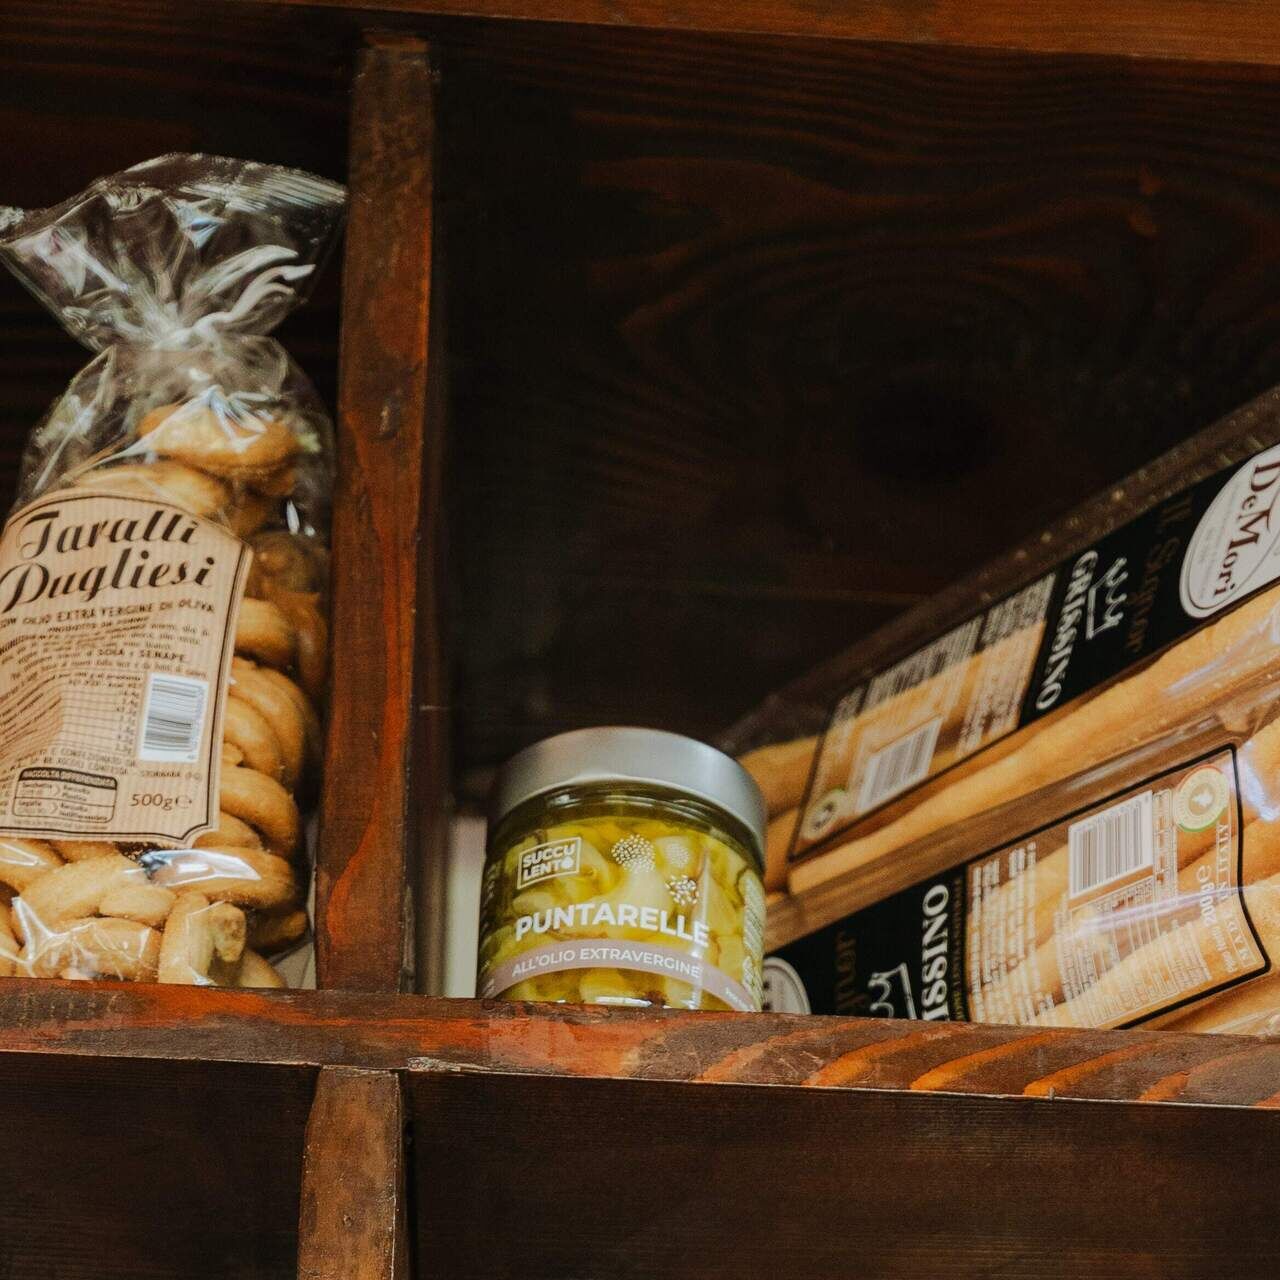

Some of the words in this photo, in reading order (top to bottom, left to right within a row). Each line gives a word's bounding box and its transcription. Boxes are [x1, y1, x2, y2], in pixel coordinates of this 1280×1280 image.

[16, 510, 199, 560] Taralli
[0, 548, 215, 614] Pugliesi
[57, 607, 95, 622] EXTRA
[1036, 550, 1099, 710] GRISSINO
[130, 793, 173, 810] 500g
[515, 902, 710, 948] PUNTARELLE
[580, 948, 701, 979] EXTRAVERGINE
[921, 884, 950, 1021] ISSINO
